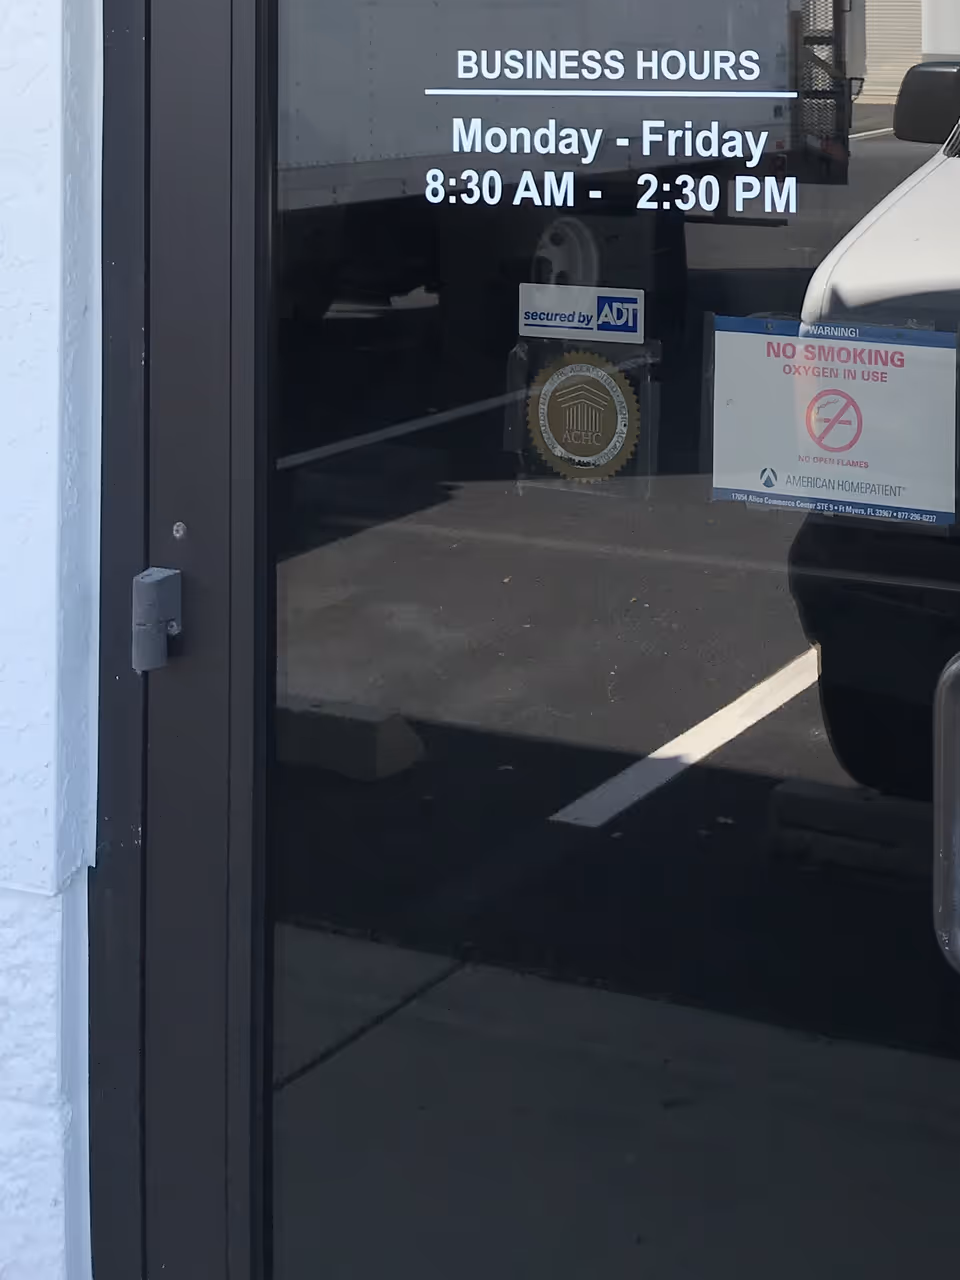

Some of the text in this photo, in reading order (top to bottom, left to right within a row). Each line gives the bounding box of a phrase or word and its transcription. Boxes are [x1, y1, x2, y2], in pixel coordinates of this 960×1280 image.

[457, 49, 761, 81] BUSINESS HOURS
[452, 117, 604, 165] Monday
[641, 119, 770, 169] Friday
[424, 168, 503, 206] 8:30
[511, 170, 576, 208] AM
[635, 172, 721, 212] 2:30
[734, 174, 797, 214] PM
[523, 302, 639, 327] secured by ADT
[808, 325, 860, 338] WARNING!
[766, 341, 905, 369] NO SMOKING
[782, 364, 888, 383] OXYGEN IN USE
[562, 430, 602, 446] ACHC
[798, 455, 869, 469] NO OPEN FLAMES
[785, 475, 835, 491] AMERICAN
[748, 495, 763, 504] Alico
[764, 497, 795, 507] Commerce
[796, 500, 816, 509] Center
[816, 503, 829, 511] STE
[845, 506, 866, 515] Myers,
[867, 508, 874, 516] FL
